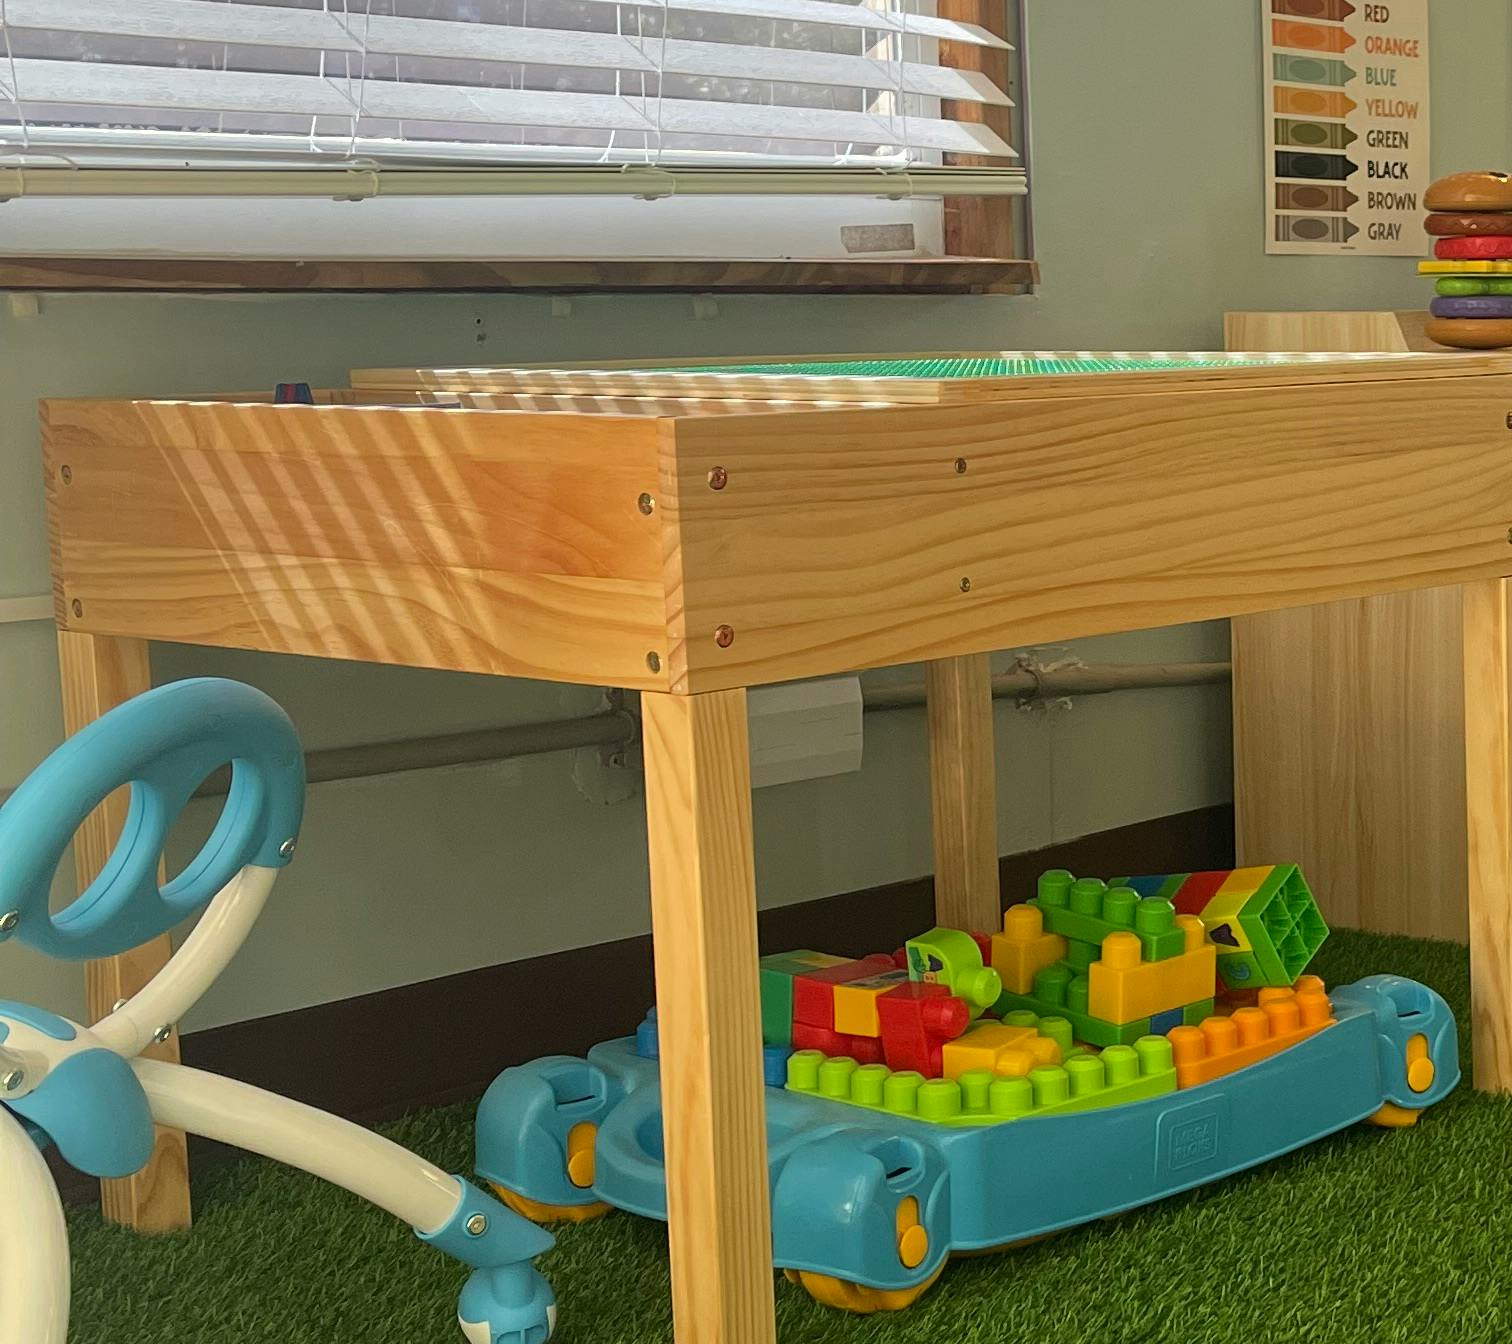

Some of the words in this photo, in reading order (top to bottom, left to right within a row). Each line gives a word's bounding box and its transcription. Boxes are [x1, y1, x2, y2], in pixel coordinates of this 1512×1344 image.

[1364, 3, 1390, 24] RED
[1364, 35, 1420, 58] ORANGE
[1365, 66, 1397, 87] BLUE
[1365, 98, 1419, 120] YELLOW
[1366, 129, 1409, 150] GREEN
[1367, 160, 1409, 180] BLACK
[1367, 191, 1417, 211] BROWN
[1367, 222, 1402, 241] GRAY
